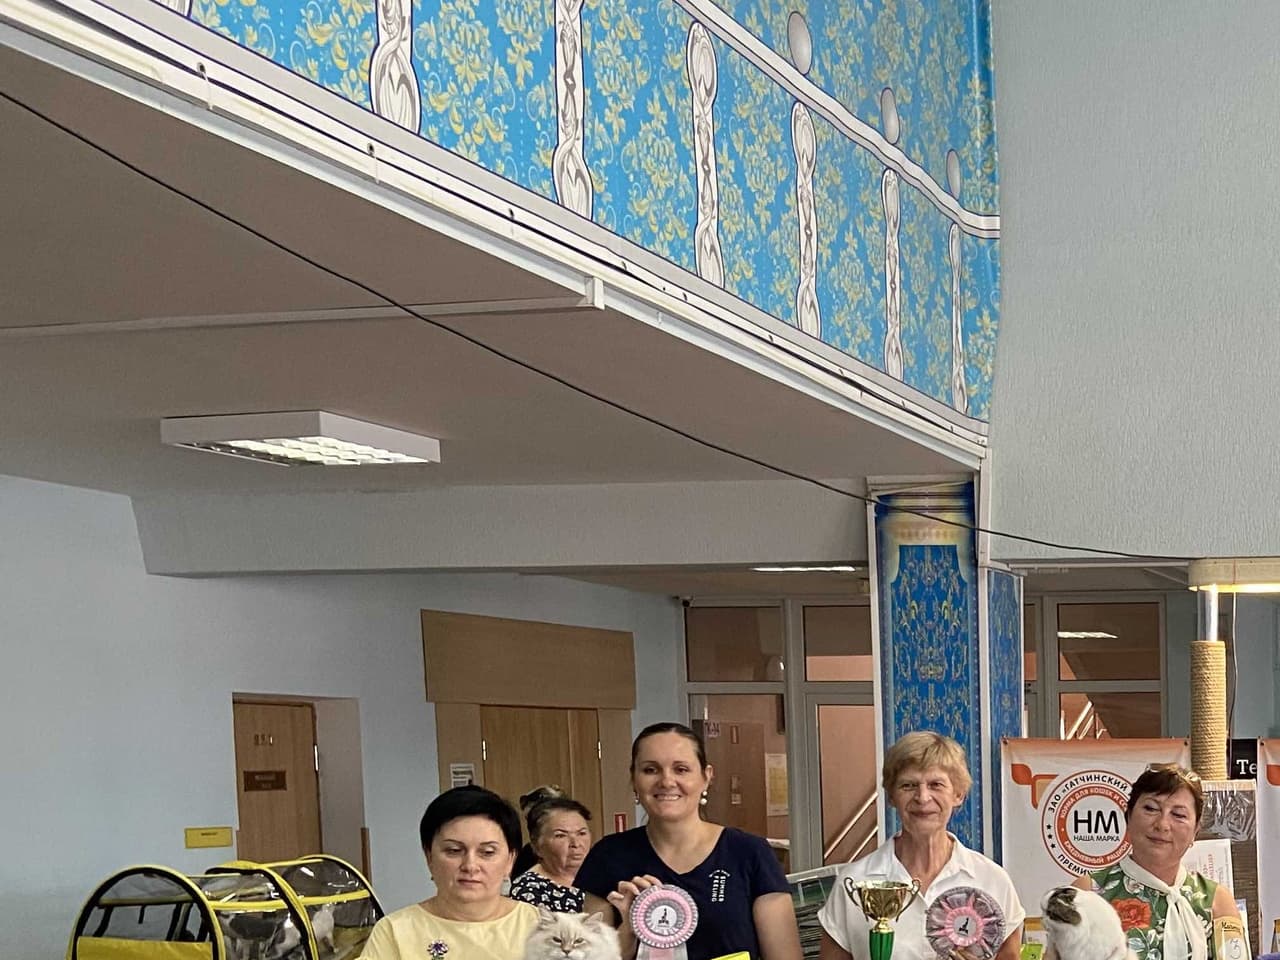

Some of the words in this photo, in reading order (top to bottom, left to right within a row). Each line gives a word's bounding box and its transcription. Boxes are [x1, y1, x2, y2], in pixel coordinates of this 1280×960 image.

[1048, 794, 1061, 813] ЗАО
[1073, 810, 1120, 834] НМ
[1058, 854, 1089, 876] ПРЕМИ
